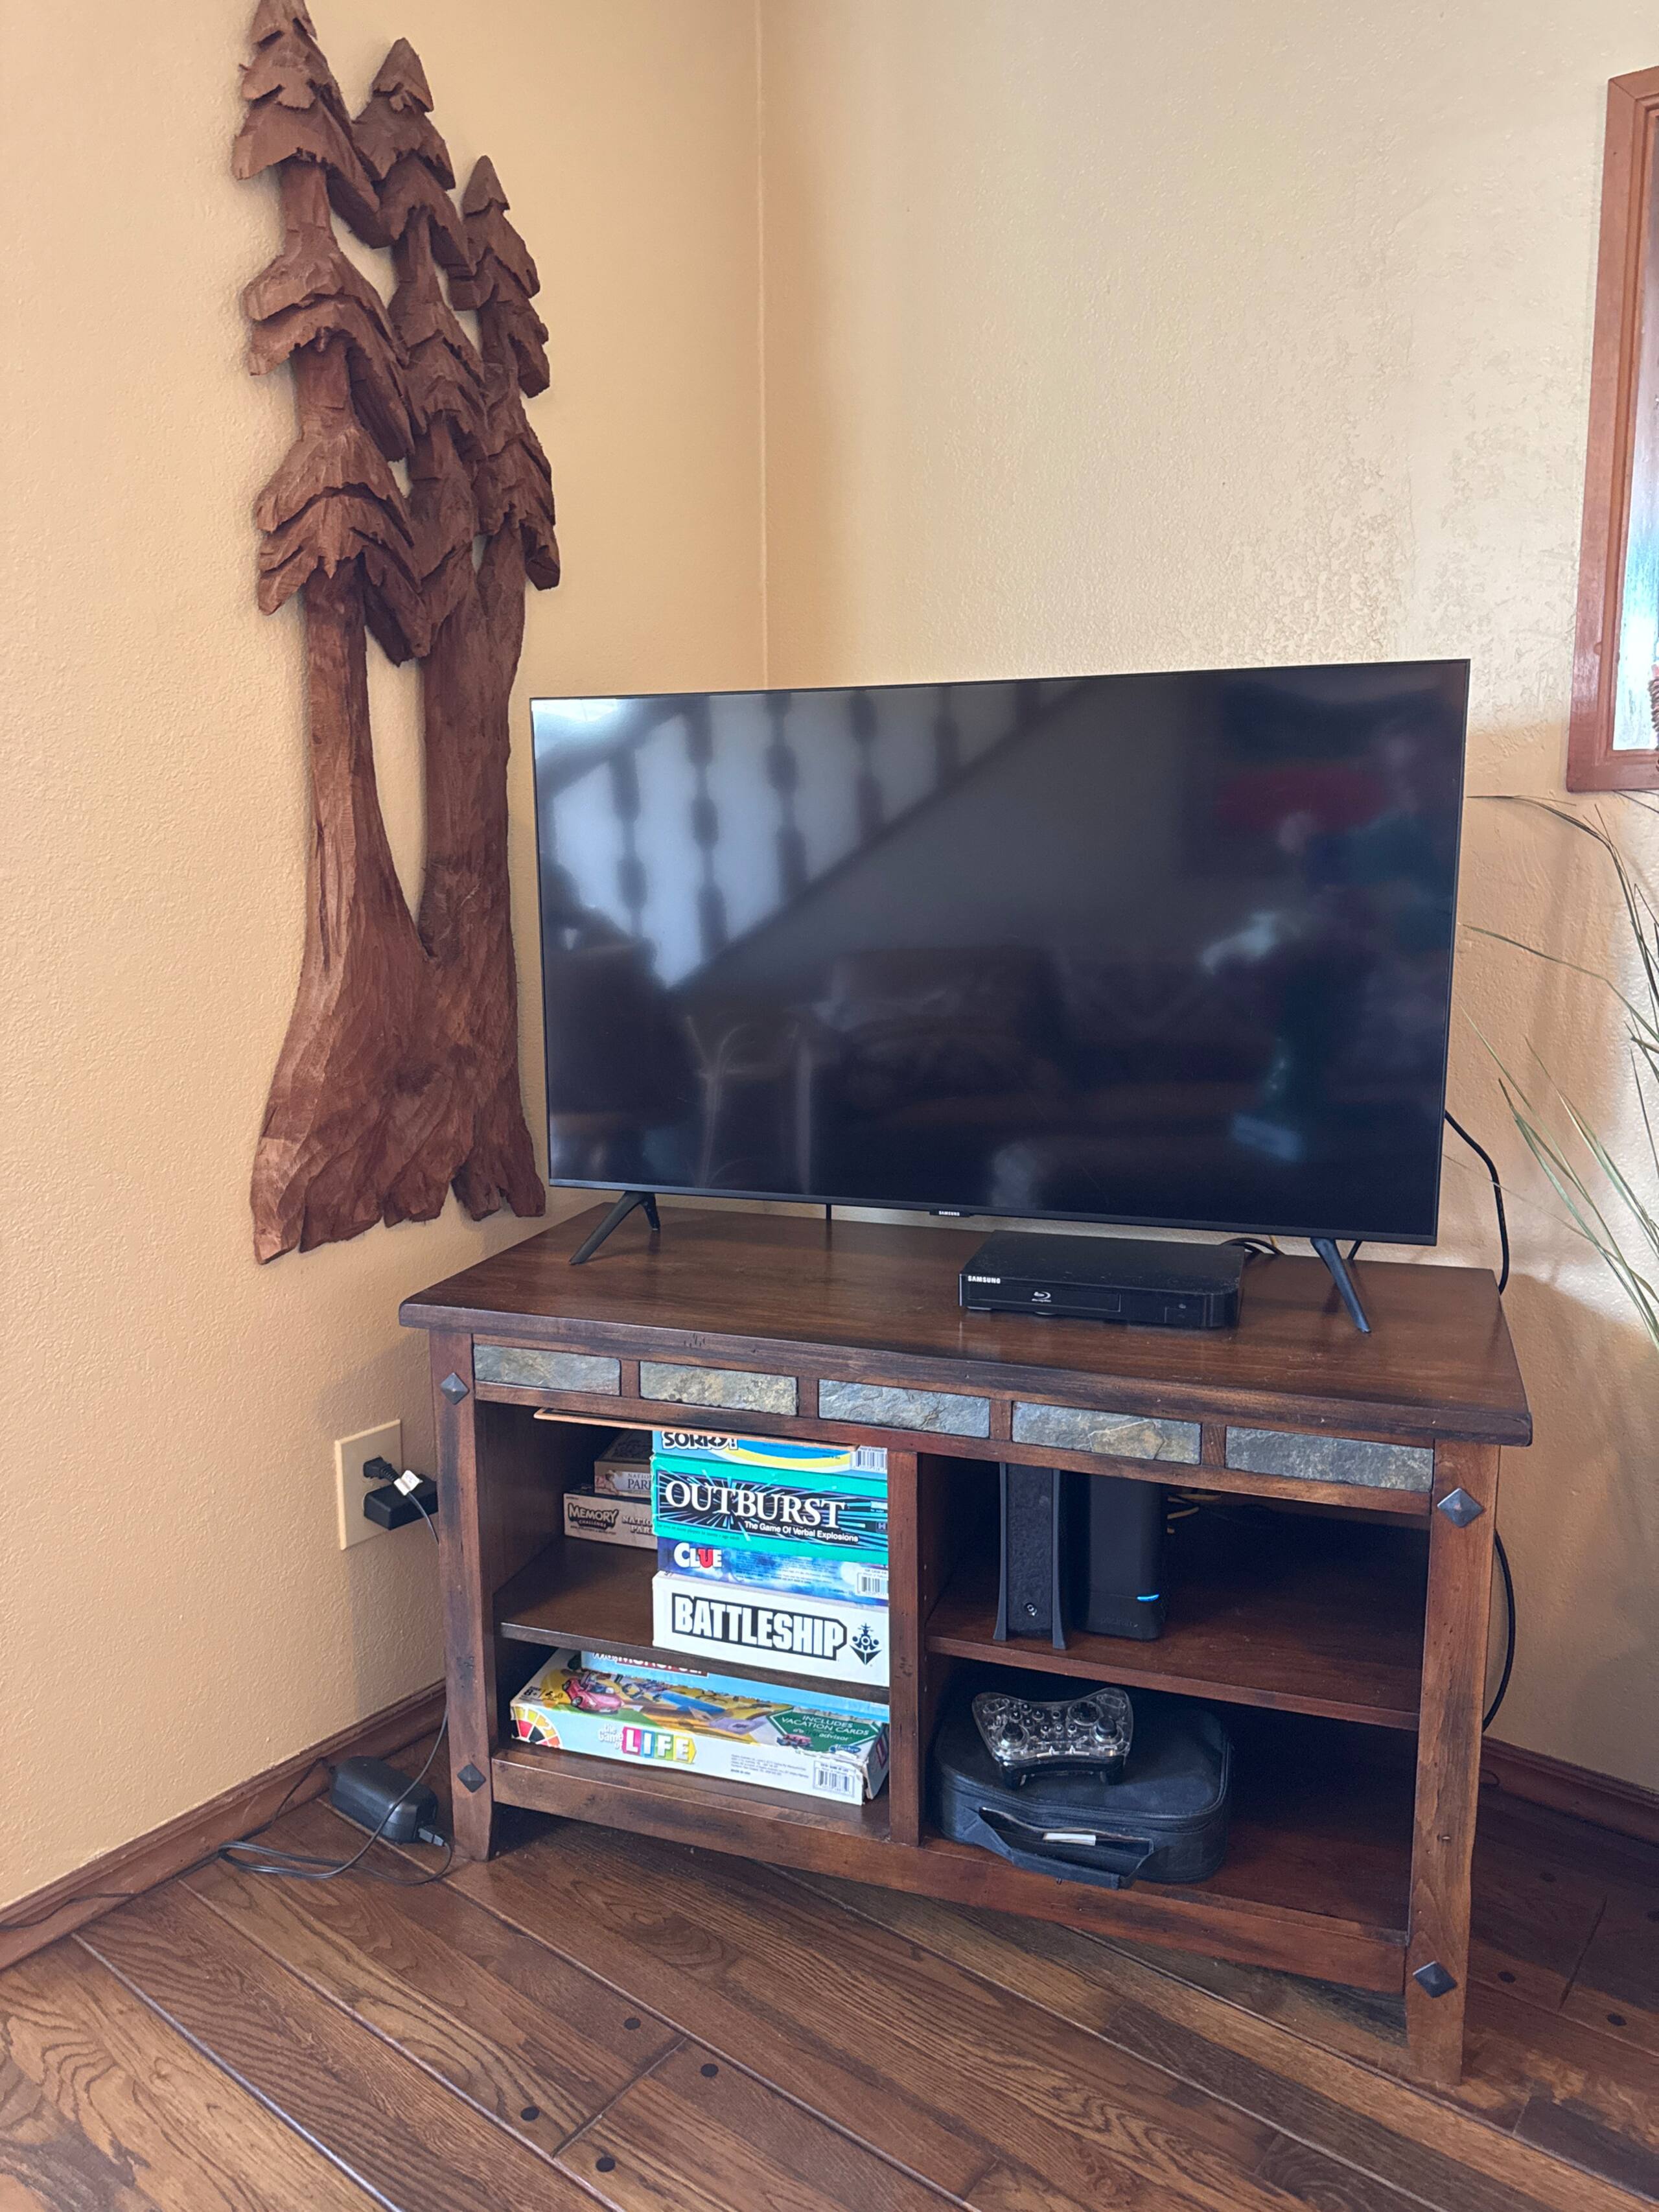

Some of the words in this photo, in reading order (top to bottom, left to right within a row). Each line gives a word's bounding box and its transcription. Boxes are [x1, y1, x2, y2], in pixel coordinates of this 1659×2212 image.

[968, 1275, 1001, 1284] SAMSUNG
[568, 1503, 619, 1524] MEMORY
[665, 1480, 846, 1529] OUTBURST
[745, 1521, 759, 1530] The
[759, 1522, 782, 1535] Game
[782, 1525, 792, 1533] Of
[793, 1526, 816, 1537] Verbal
[817, 1530, 859, 1543] Explosions
[673, 1542, 723, 1568] CLUE
[674, 1594, 844, 1659] BATTLESHIP
[603, 1723, 617, 1734] the
[781, 1717, 833, 1731] VACATION
[802, 1714, 853, 1729] INCLUDES
[597, 1729, 623, 1744] Game
[625, 1729, 689, 1762] LIFE
